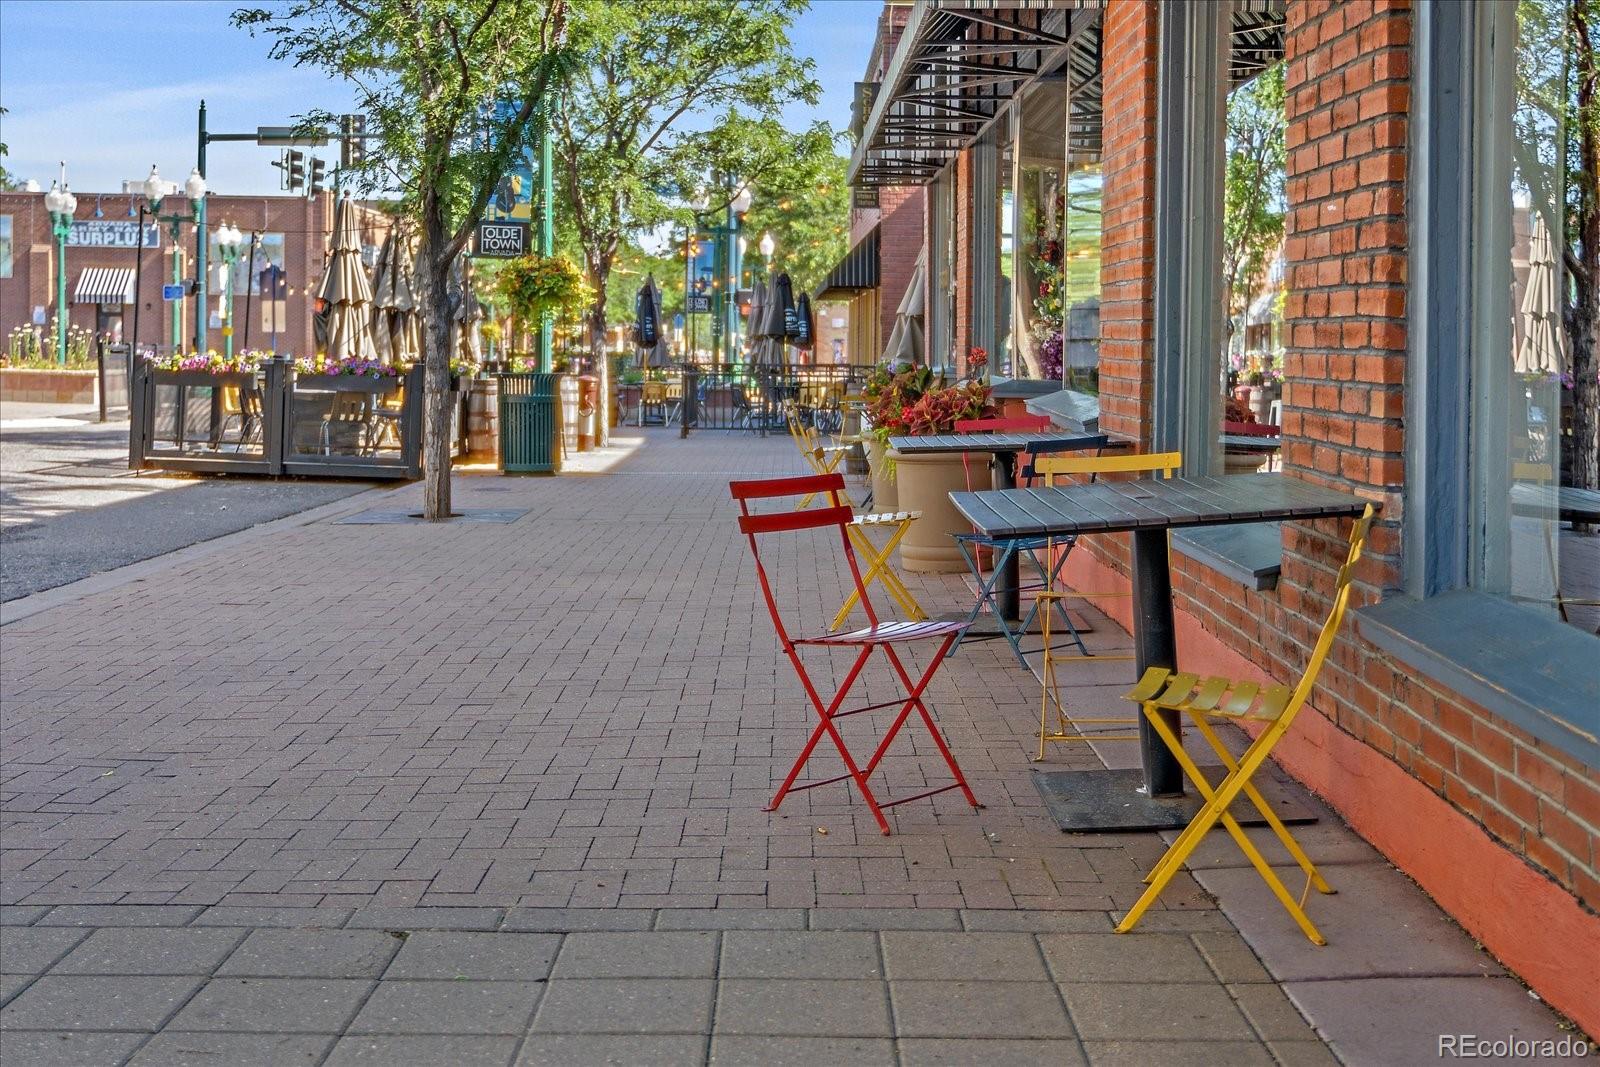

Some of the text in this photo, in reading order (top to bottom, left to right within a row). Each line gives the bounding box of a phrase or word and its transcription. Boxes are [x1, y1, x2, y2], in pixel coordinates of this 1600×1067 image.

[67, 231, 150, 246] SURPLUS
[485, 227, 518, 239] OLDE
[483, 238, 520, 250] TOWN
